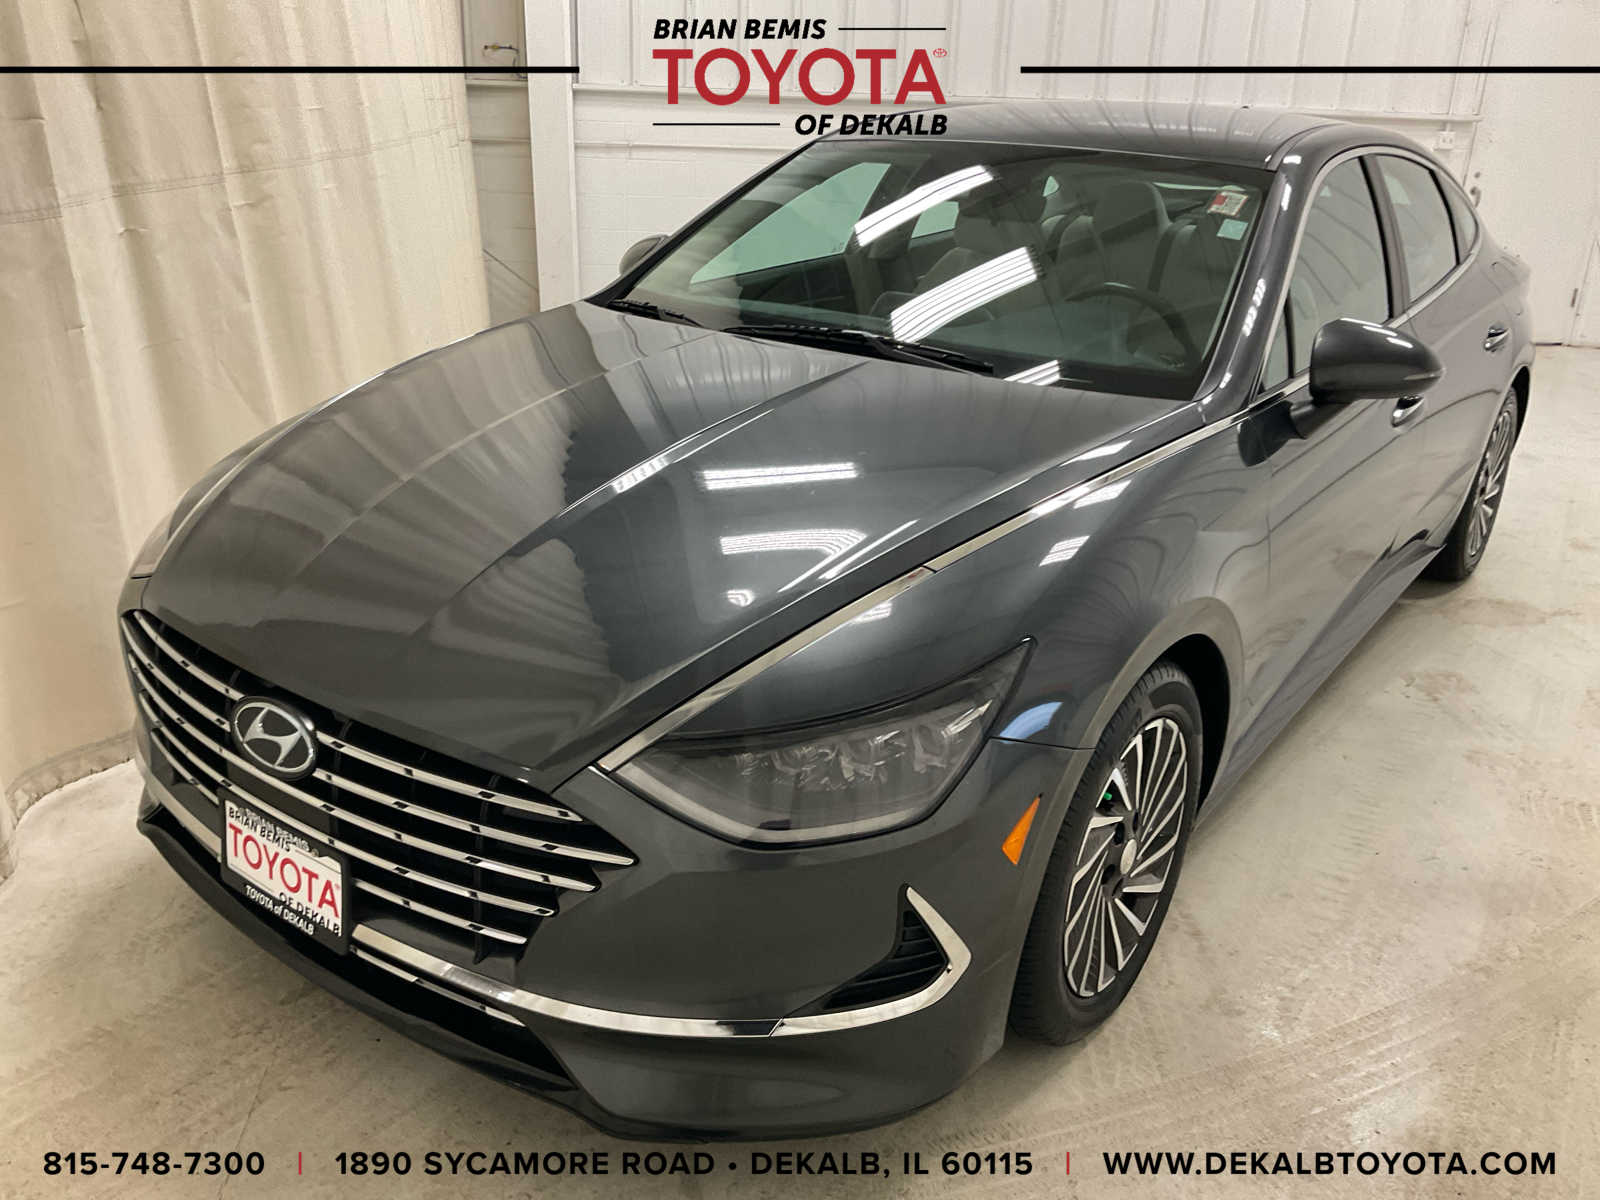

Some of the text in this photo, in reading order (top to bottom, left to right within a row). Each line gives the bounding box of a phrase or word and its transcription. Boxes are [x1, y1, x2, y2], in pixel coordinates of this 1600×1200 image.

[228, 806, 291, 852] BRIAN BEMIS
[228, 822, 340, 919] TOYOTA
[246, 885, 315, 936] TOYOTA of DEKALB
[279, 892, 342, 936] OF DEKALB
